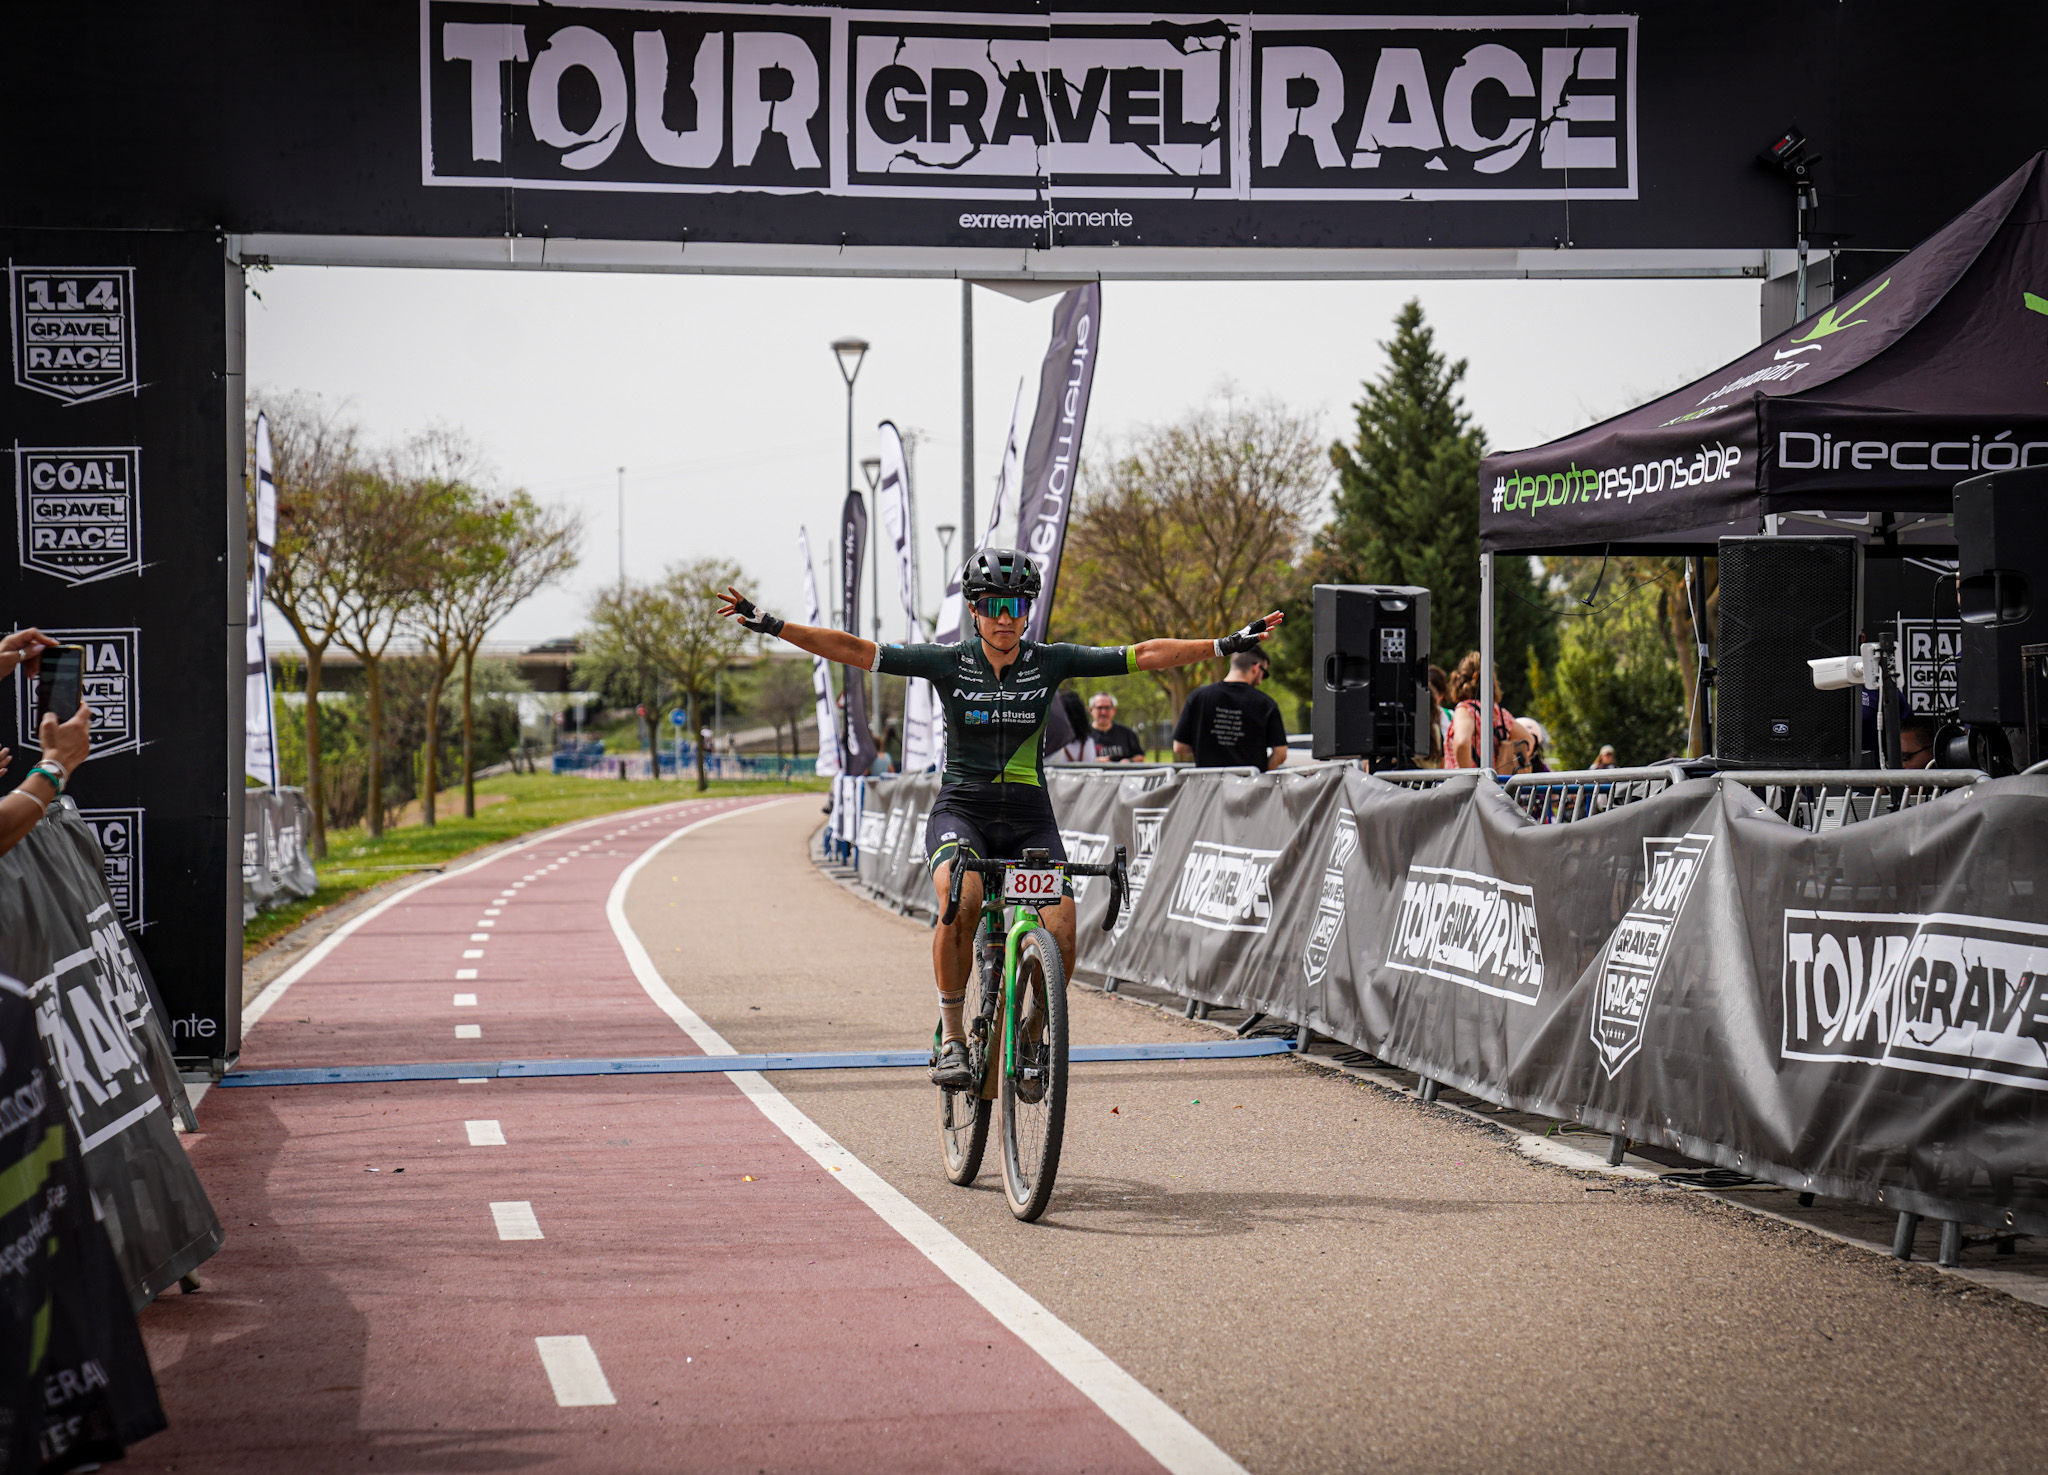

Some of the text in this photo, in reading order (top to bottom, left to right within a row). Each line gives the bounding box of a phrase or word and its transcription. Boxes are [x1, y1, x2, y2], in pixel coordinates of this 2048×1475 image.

[442, 21, 1618, 174] TOUR GRAVEL RACE
[28, 280, 119, 311] 114
[30, 322, 119, 337] GRAVEL
[29, 347, 121, 369] RACE
[32, 461, 125, 490] COAL
[1491, 441, 1742, 517] #deporteresponsable
[36, 503, 125, 517] GRAVEL
[34, 527, 126, 549] RACE
[991, 709, 1036, 719] Asturias
[1014, 873, 1054, 893] 802
[1614, 927, 1663, 958] GRAVEL
[1604, 973, 1651, 1016] RACE
